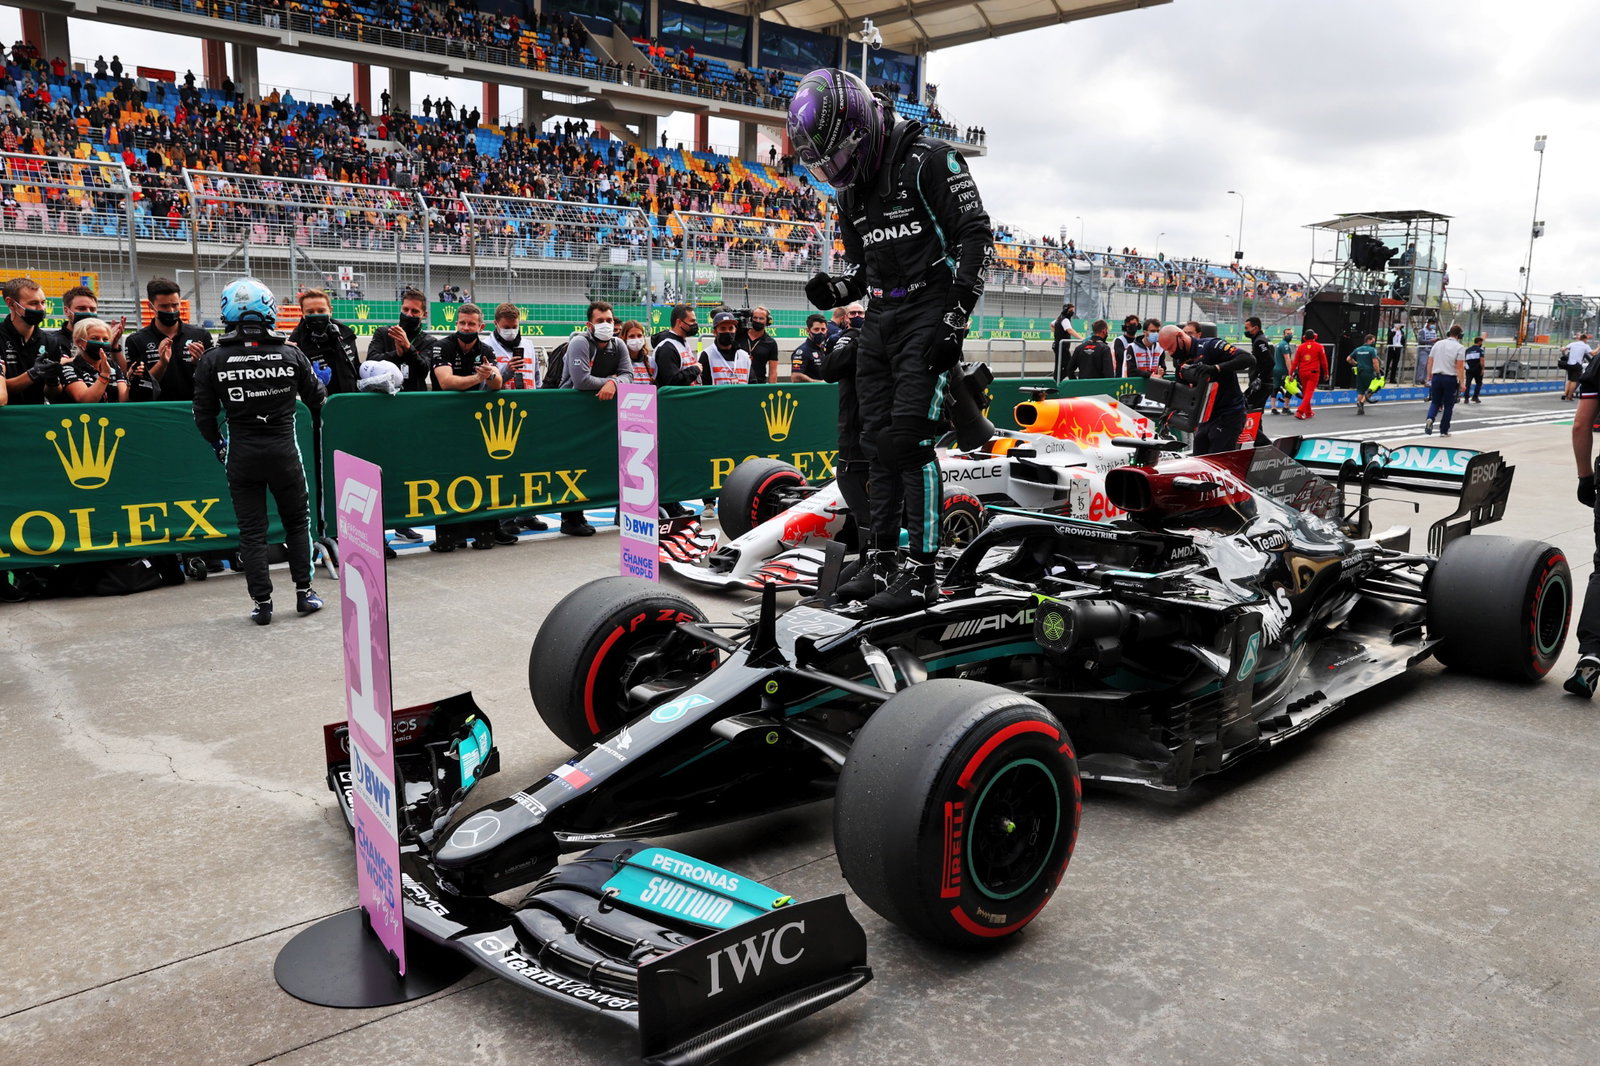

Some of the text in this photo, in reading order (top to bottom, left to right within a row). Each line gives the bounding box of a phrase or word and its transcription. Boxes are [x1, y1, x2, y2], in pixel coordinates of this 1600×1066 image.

[958, 190, 976, 202] IWC
[217, 366, 295, 382] PETRONAS
[245, 386, 291, 398] TeamViewer
[1045, 442, 1066, 453] citrix
[1310, 440, 1473, 473] PETONAS
[621, 430, 655, 506] 3
[709, 450, 840, 490] REX
[404, 469, 590, 518] ROLEX
[943, 493, 980, 511] ZERO
[0, 498, 228, 557] OLEX
[633, 519, 654, 536] BWT
[1058, 526, 1118, 540] CROWDSTRIKE
[623, 552, 653, 570] CHANGE
[629, 564, 653, 579] WORLD
[344, 561, 387, 754] 1
[395, 734, 412, 743] enics
[364, 762, 391, 817] BWT
[357, 825, 395, 890] CHANGE
[941, 801, 965, 898] PIRELLI
[366, 859, 395, 910] WORLD
[651, 853, 740, 892] PETRONAS
[405, 882, 451, 918] AMG
[639, 876, 735, 924] SYNTIUM
[706, 919, 806, 998] IWC
[497, 950, 639, 1010] TeamViewer
